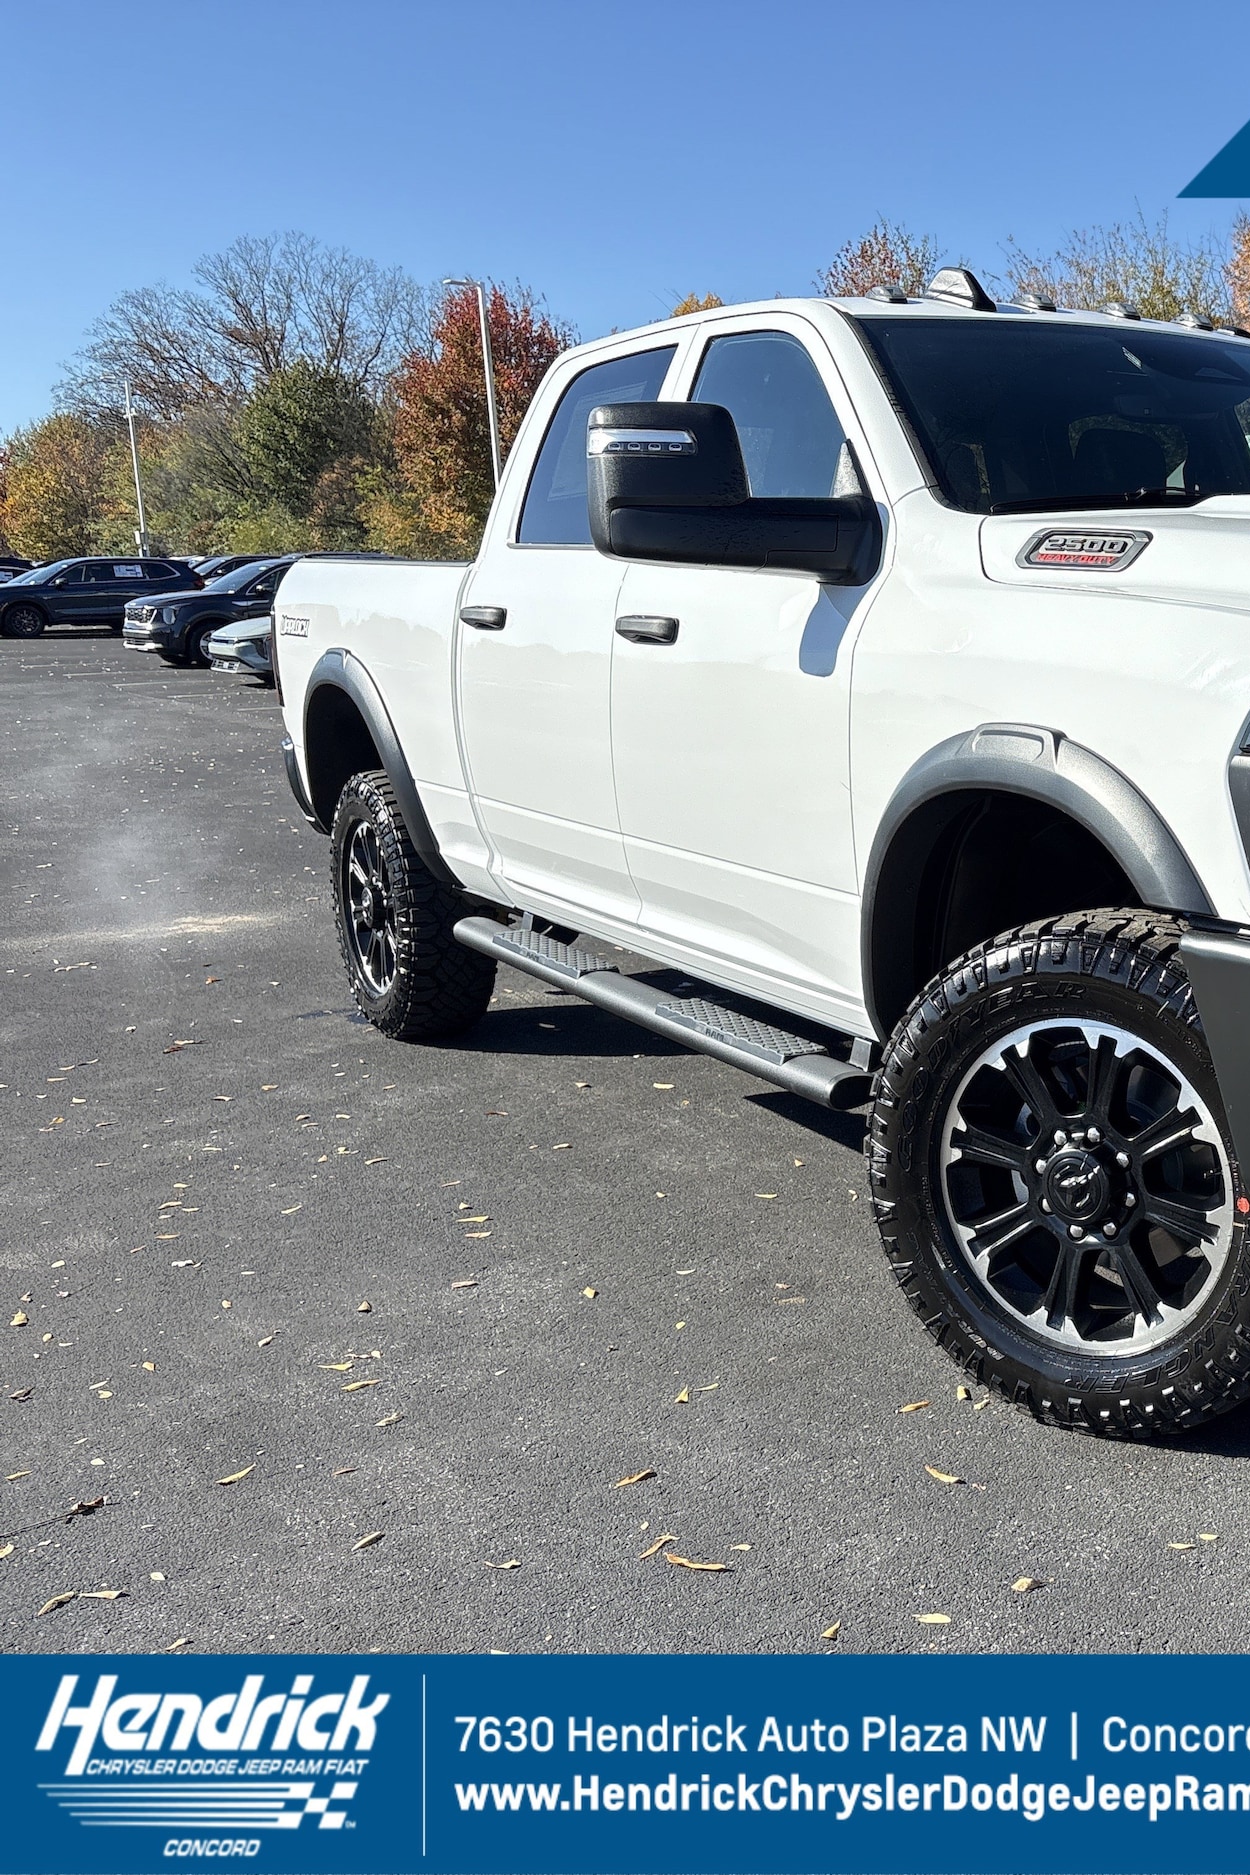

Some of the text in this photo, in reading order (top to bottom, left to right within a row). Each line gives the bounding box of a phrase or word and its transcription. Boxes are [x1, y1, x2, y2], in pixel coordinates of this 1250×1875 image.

[1045, 537, 1129, 554] 2500
[1036, 553, 1116, 565] HEAVY DUTY
[897, 979, 1087, 1173] GOODYEAR
